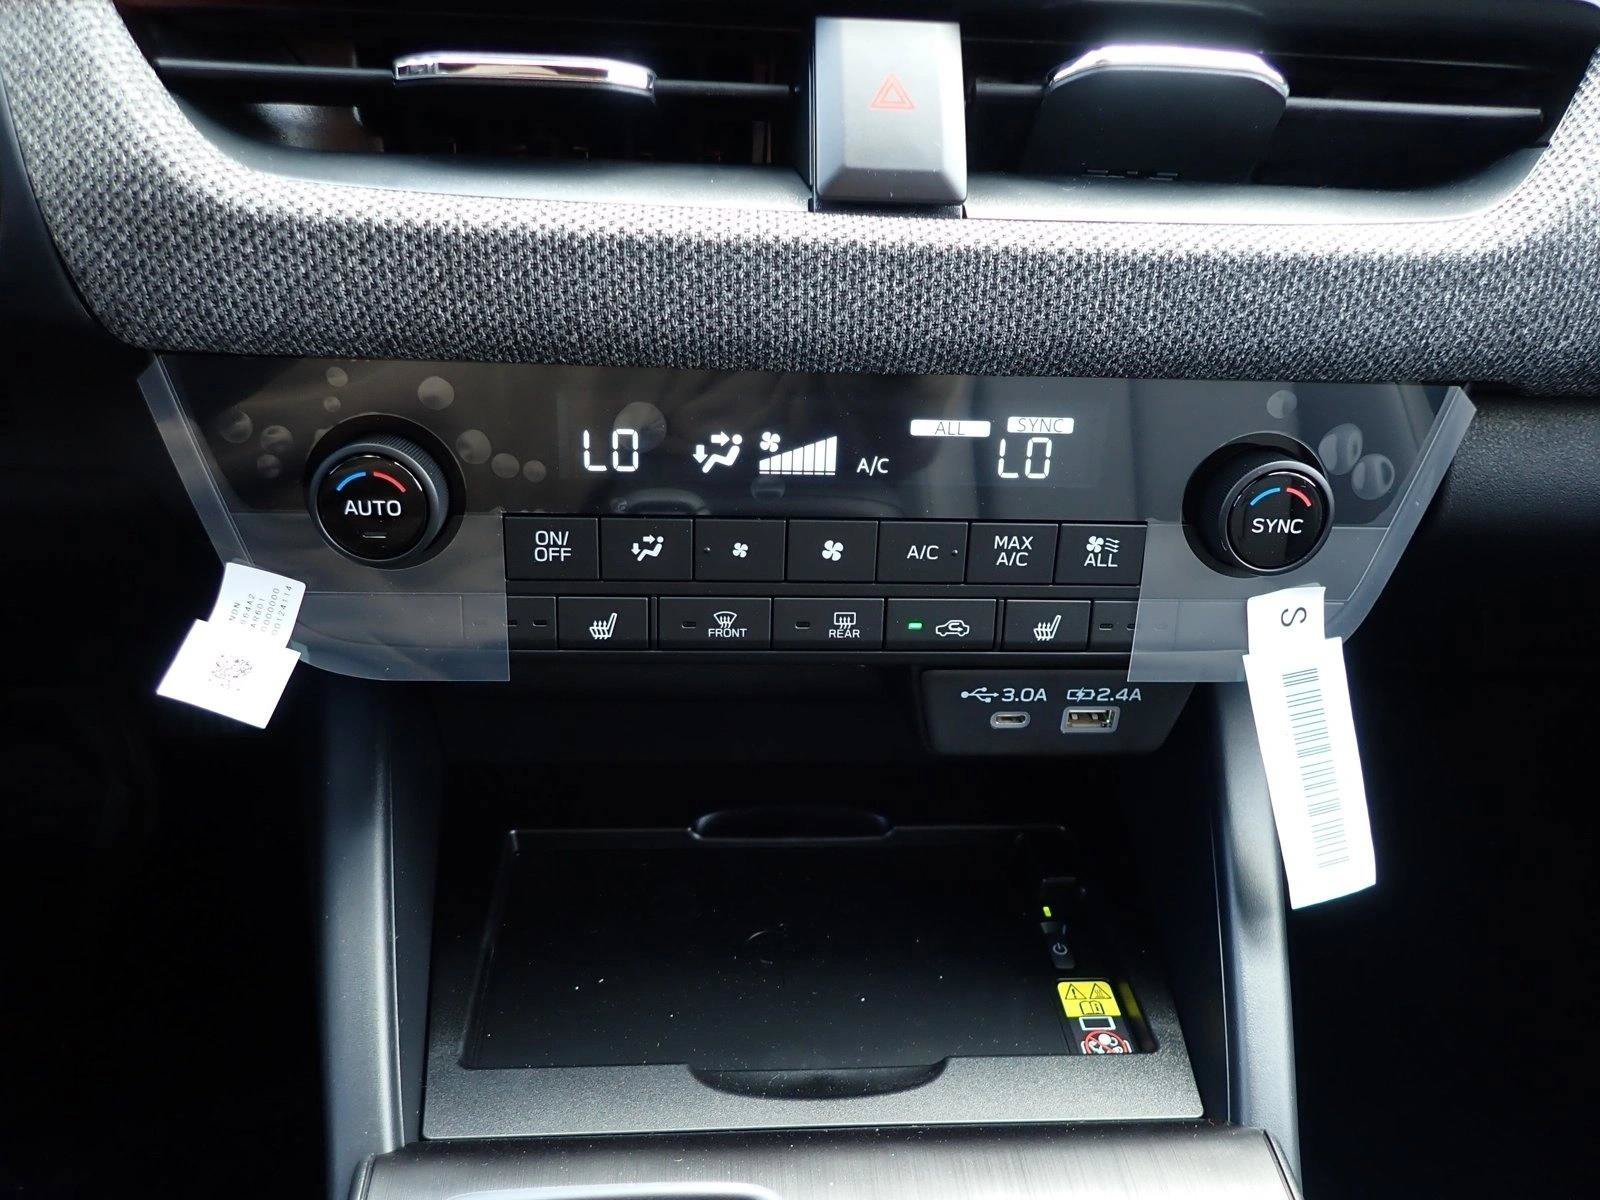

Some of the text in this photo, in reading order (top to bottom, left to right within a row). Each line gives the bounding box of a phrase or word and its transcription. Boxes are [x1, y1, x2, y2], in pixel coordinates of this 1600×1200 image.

[934, 421, 967, 436] ALL
[1016, 417, 1065, 433] SYNC
[856, 456, 890, 476] A/C
[344, 499, 402, 517] AUTO
[1251, 517, 1304, 534] SYNC
[535, 530, 569, 547] ON/
[994, 535, 1034, 550] MAX
[534, 547, 572, 562] OFF
[906, 544, 940, 560] A/C
[996, 551, 1029, 567] A/C
[1084, 553, 1118, 567] ALL
[1281, 606, 1307, 627] S
[708, 628, 748, 638] FRONT
[828, 629, 861, 639] REAR
[1001, 687, 1048, 702] 3.0A
[1097, 687, 1142, 702] 2.4A
